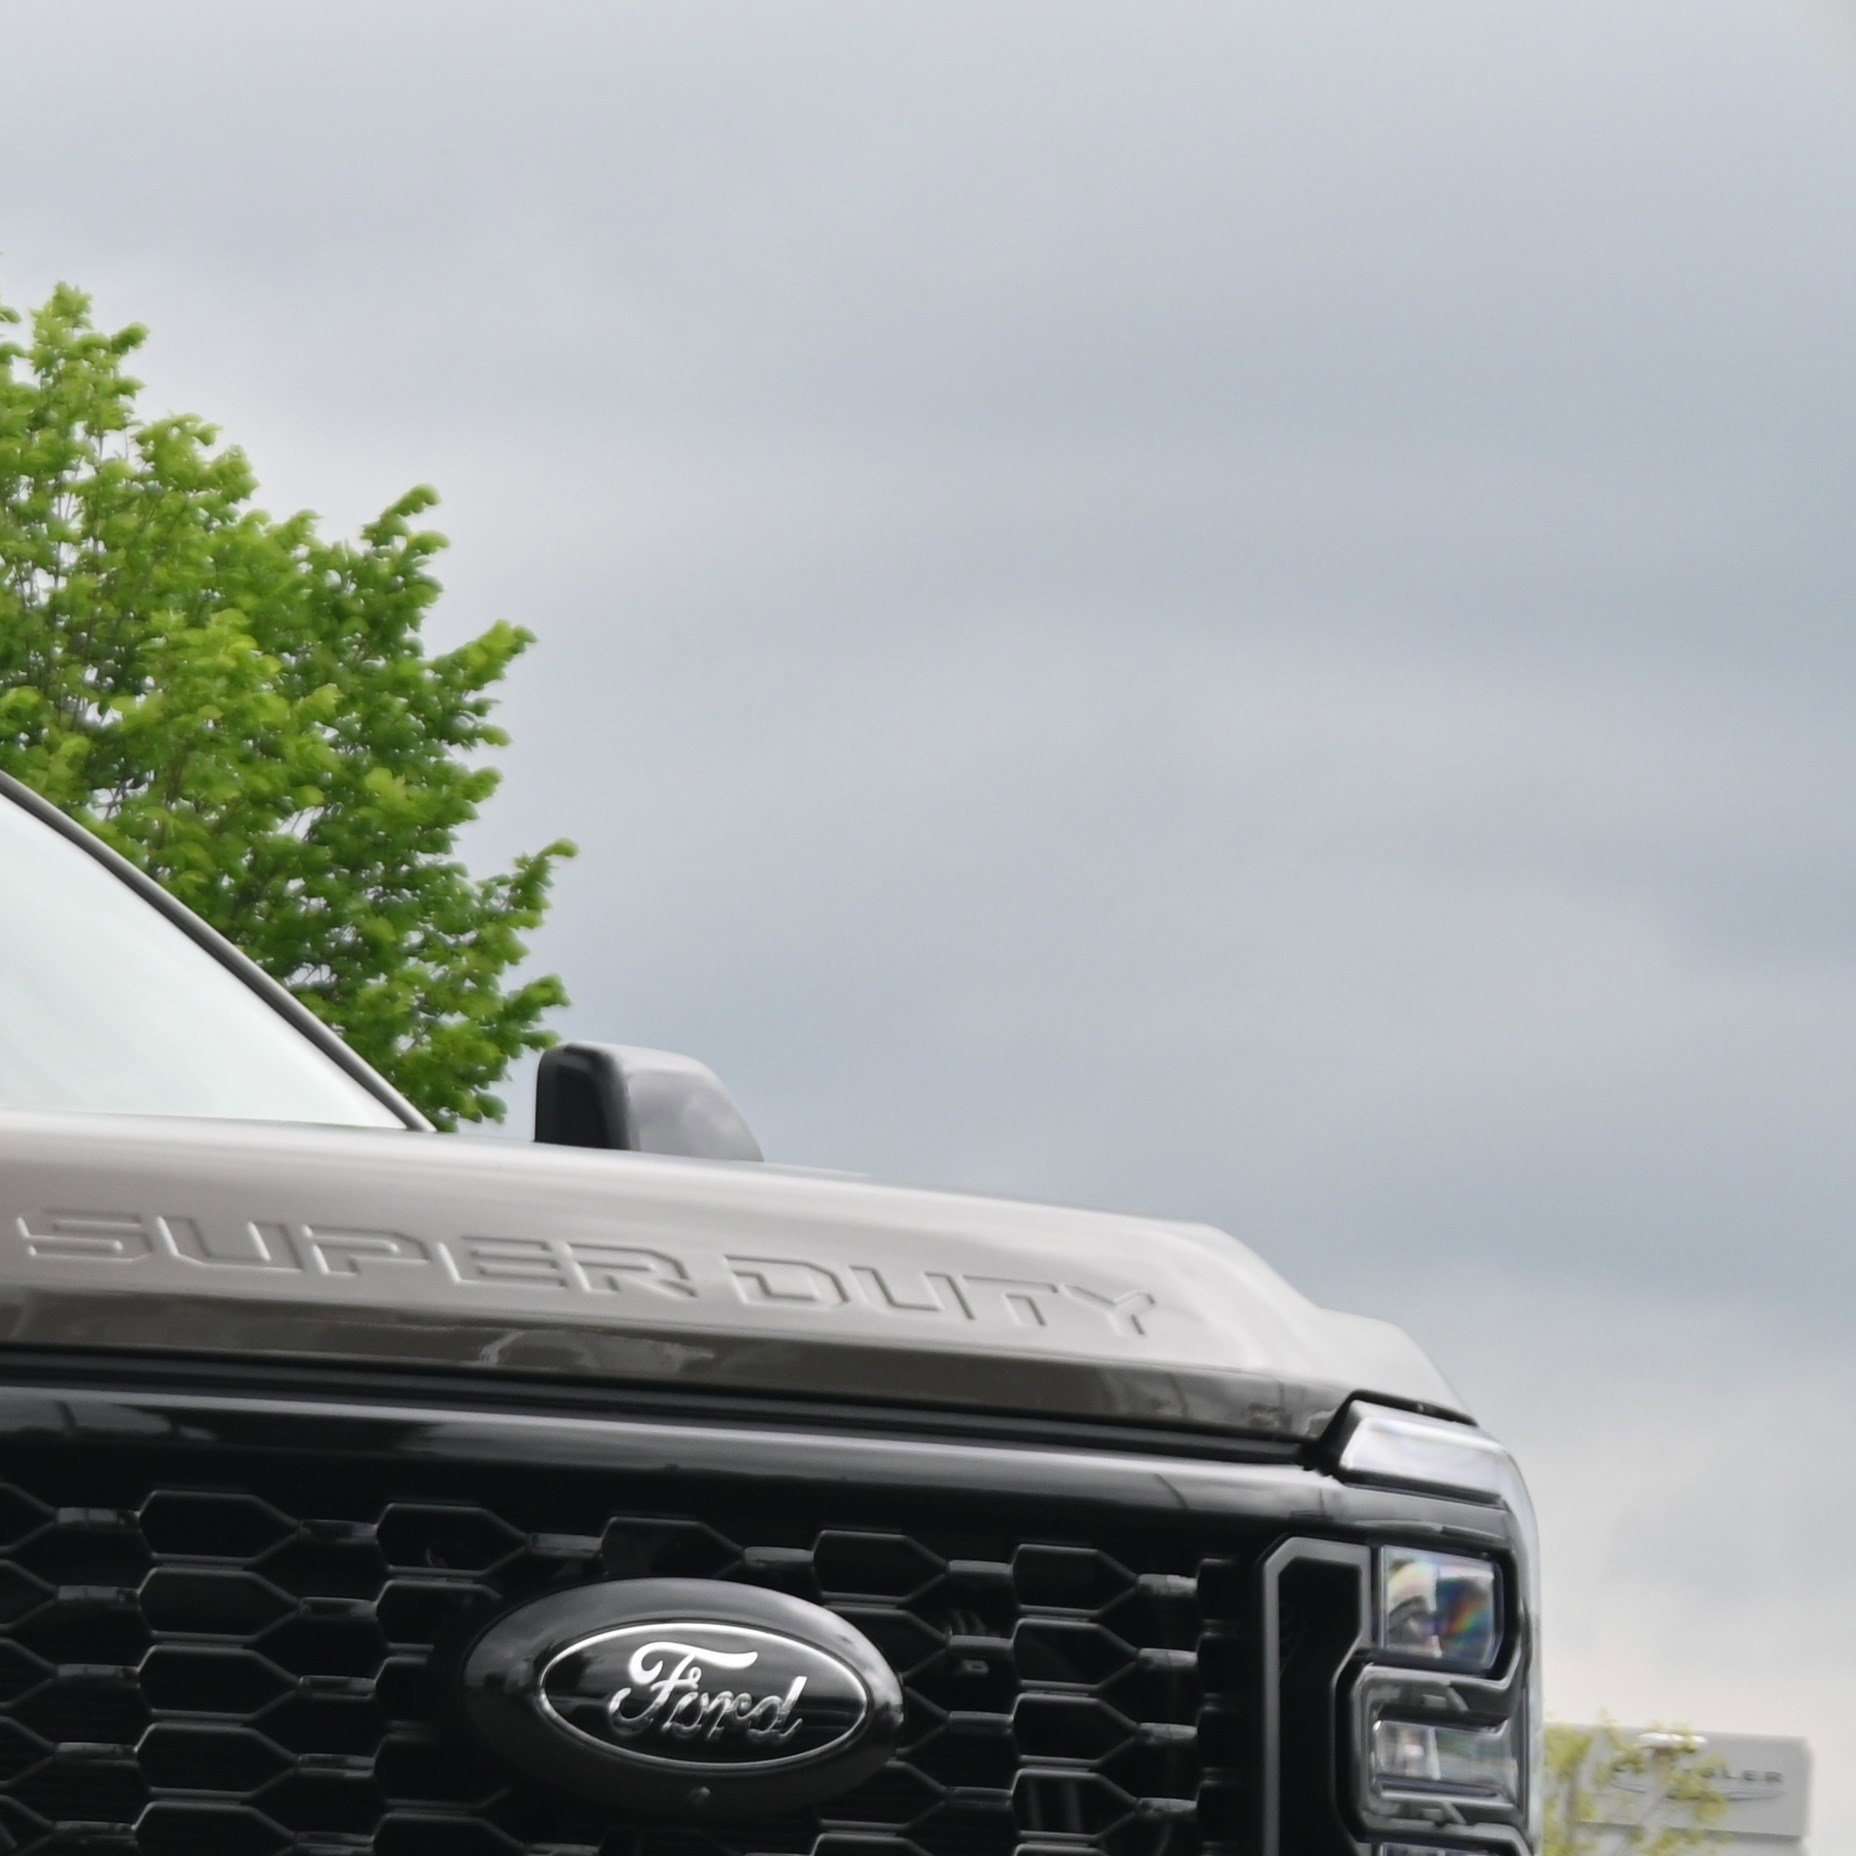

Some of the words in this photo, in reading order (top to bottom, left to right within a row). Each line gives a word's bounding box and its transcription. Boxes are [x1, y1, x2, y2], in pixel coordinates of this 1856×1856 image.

[15, 1208, 700, 1299] SUPER
[722, 1250, 1157, 1336] DUTY
[607, 1640, 808, 1744] Ford
